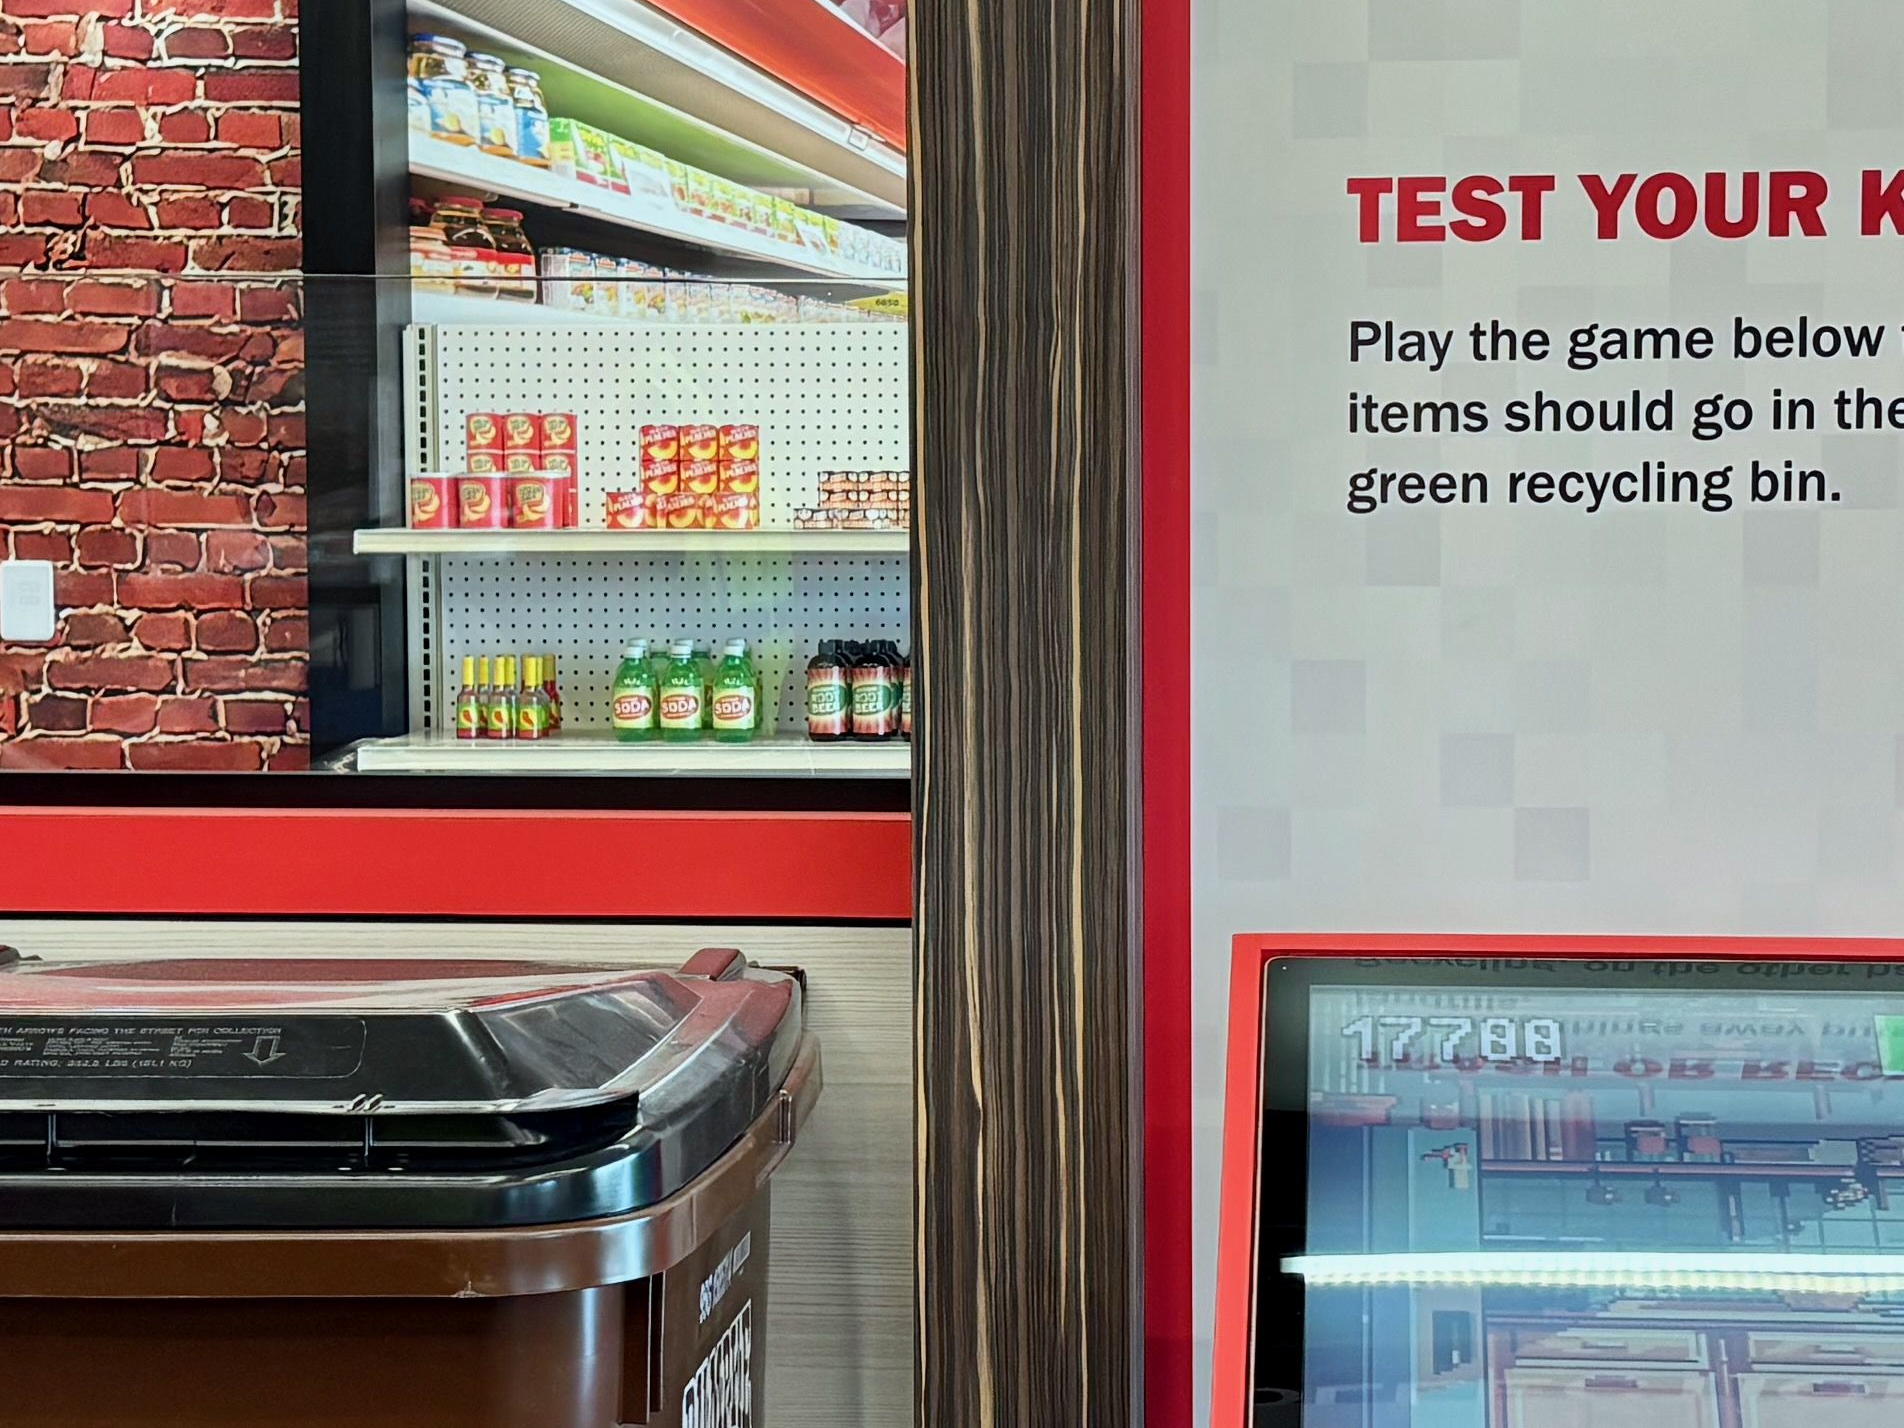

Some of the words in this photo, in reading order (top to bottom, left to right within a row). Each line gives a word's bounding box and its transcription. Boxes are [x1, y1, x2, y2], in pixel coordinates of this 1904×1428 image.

[1346, 174, 1557, 244] TEST
[1579, 170, 1829, 241] YOUR
[1349, 319, 1455, 373] Play
[1467, 318, 1551, 363] the
[1566, 322, 1715, 372] game
[1732, 314, 1887, 360] below
[1348, 390, 1490, 435] items
[1503, 388, 1674, 434] should
[1690, 392, 1754, 442] go
[1771, 387, 1816, 431] in
[1345, 466, 1489, 516] green
[1508, 459, 1735, 515] recycling
[1750, 458, 1842, 504] bin.
[614, 697, 650, 715] SODA
[661, 697, 697, 714] SODA
[715, 698, 750, 715] SODA
[1341, 1016, 1564, 1063] 17700
